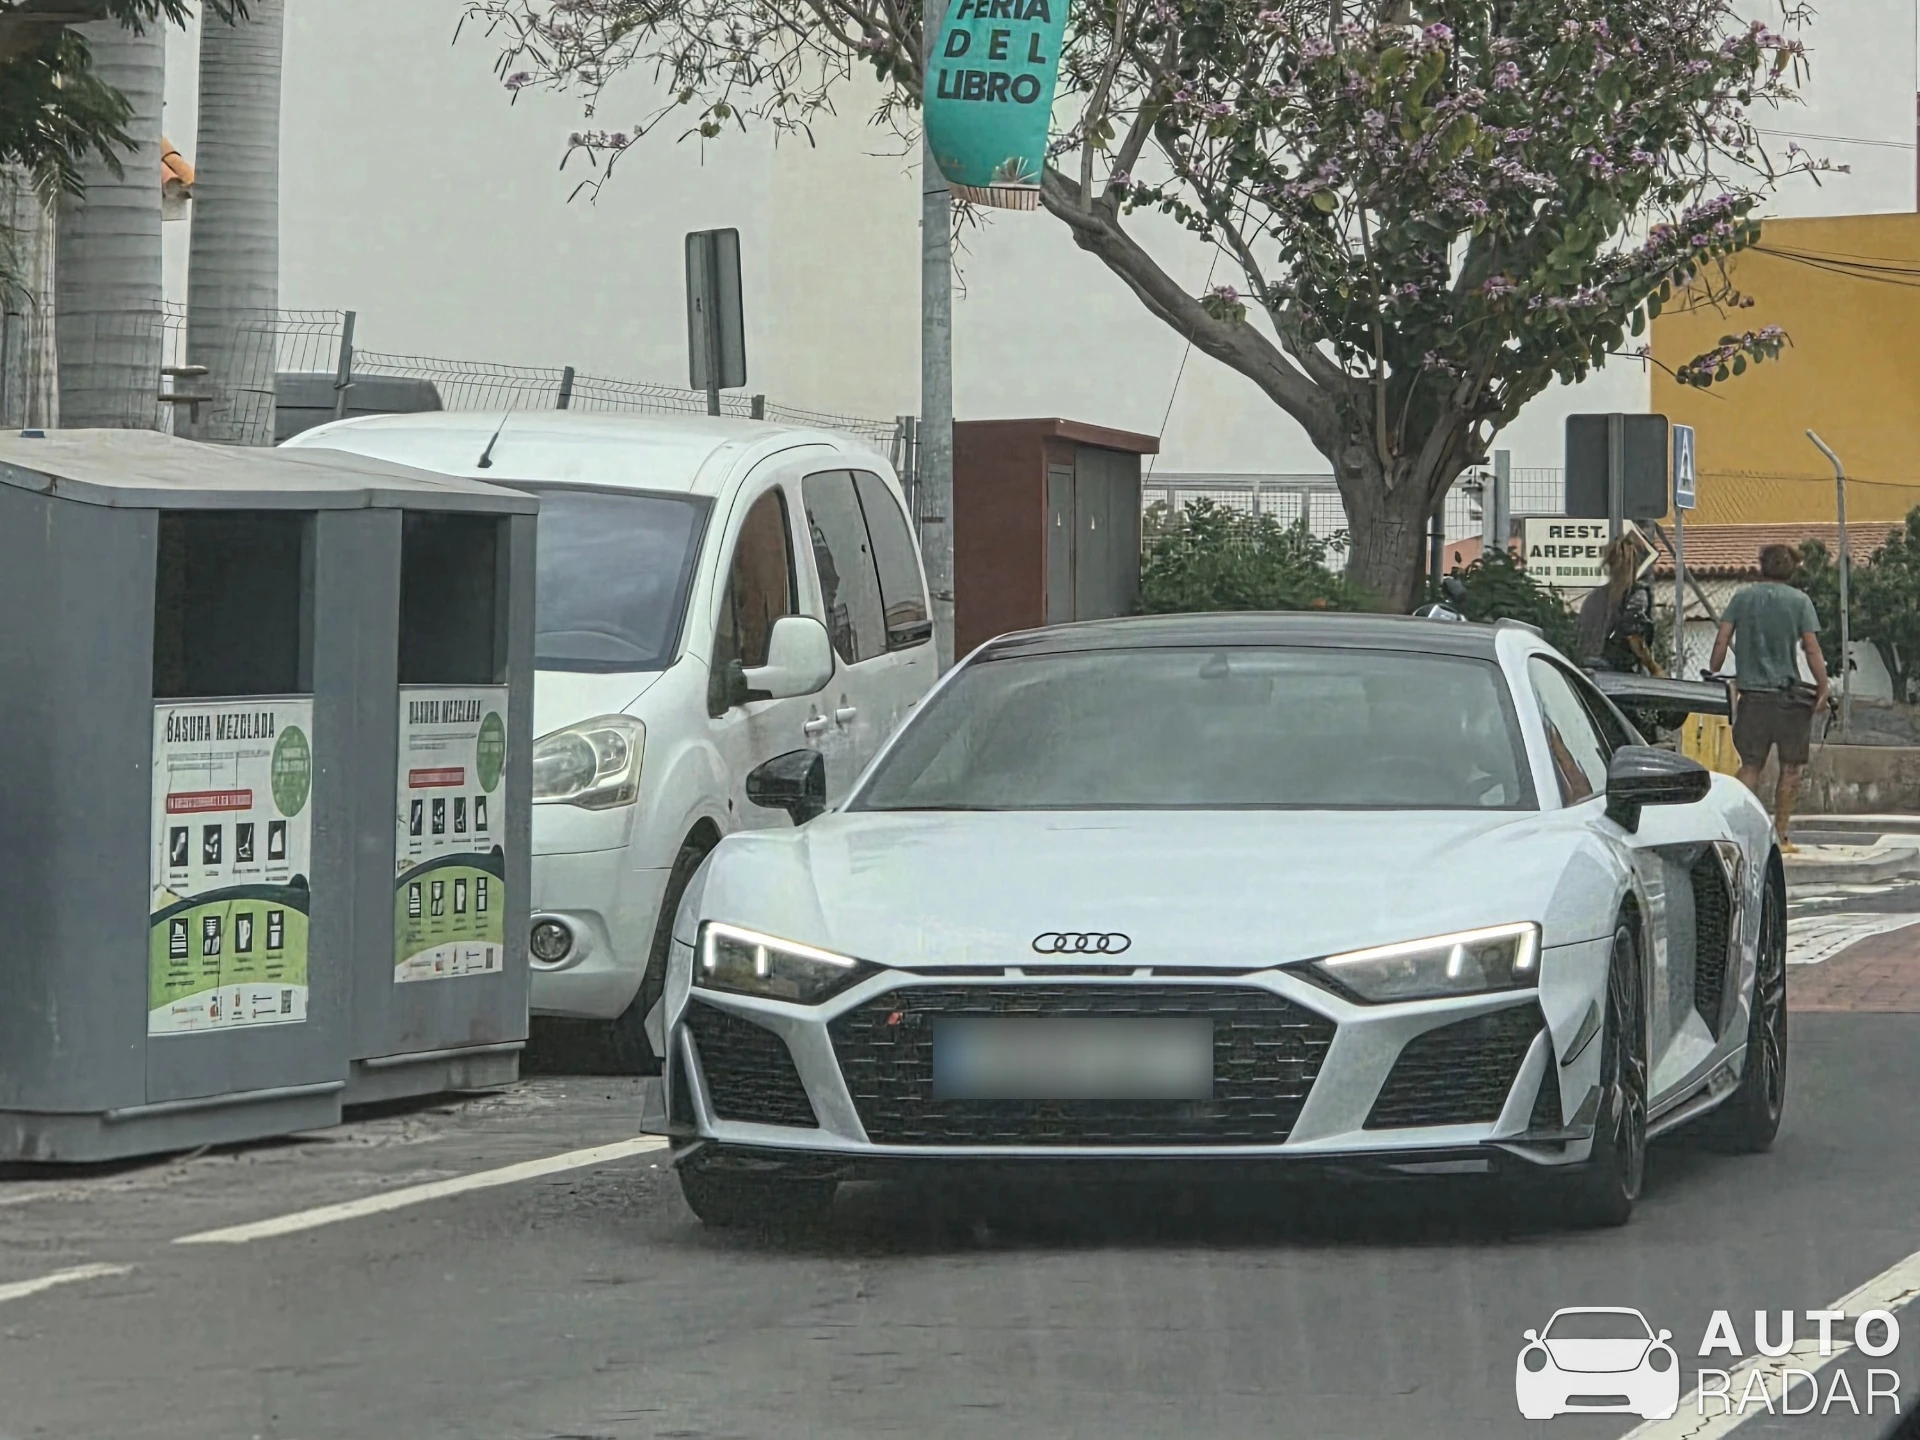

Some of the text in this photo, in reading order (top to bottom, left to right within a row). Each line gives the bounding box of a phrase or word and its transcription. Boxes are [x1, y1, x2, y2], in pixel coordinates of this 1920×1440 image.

[957, 0, 1051, 23] FERIA
[937, 69, 1041, 104] LIBRO
[1549, 525, 1606, 538] REST.
[167, 711, 275, 742] BASURA MEZCLADA
